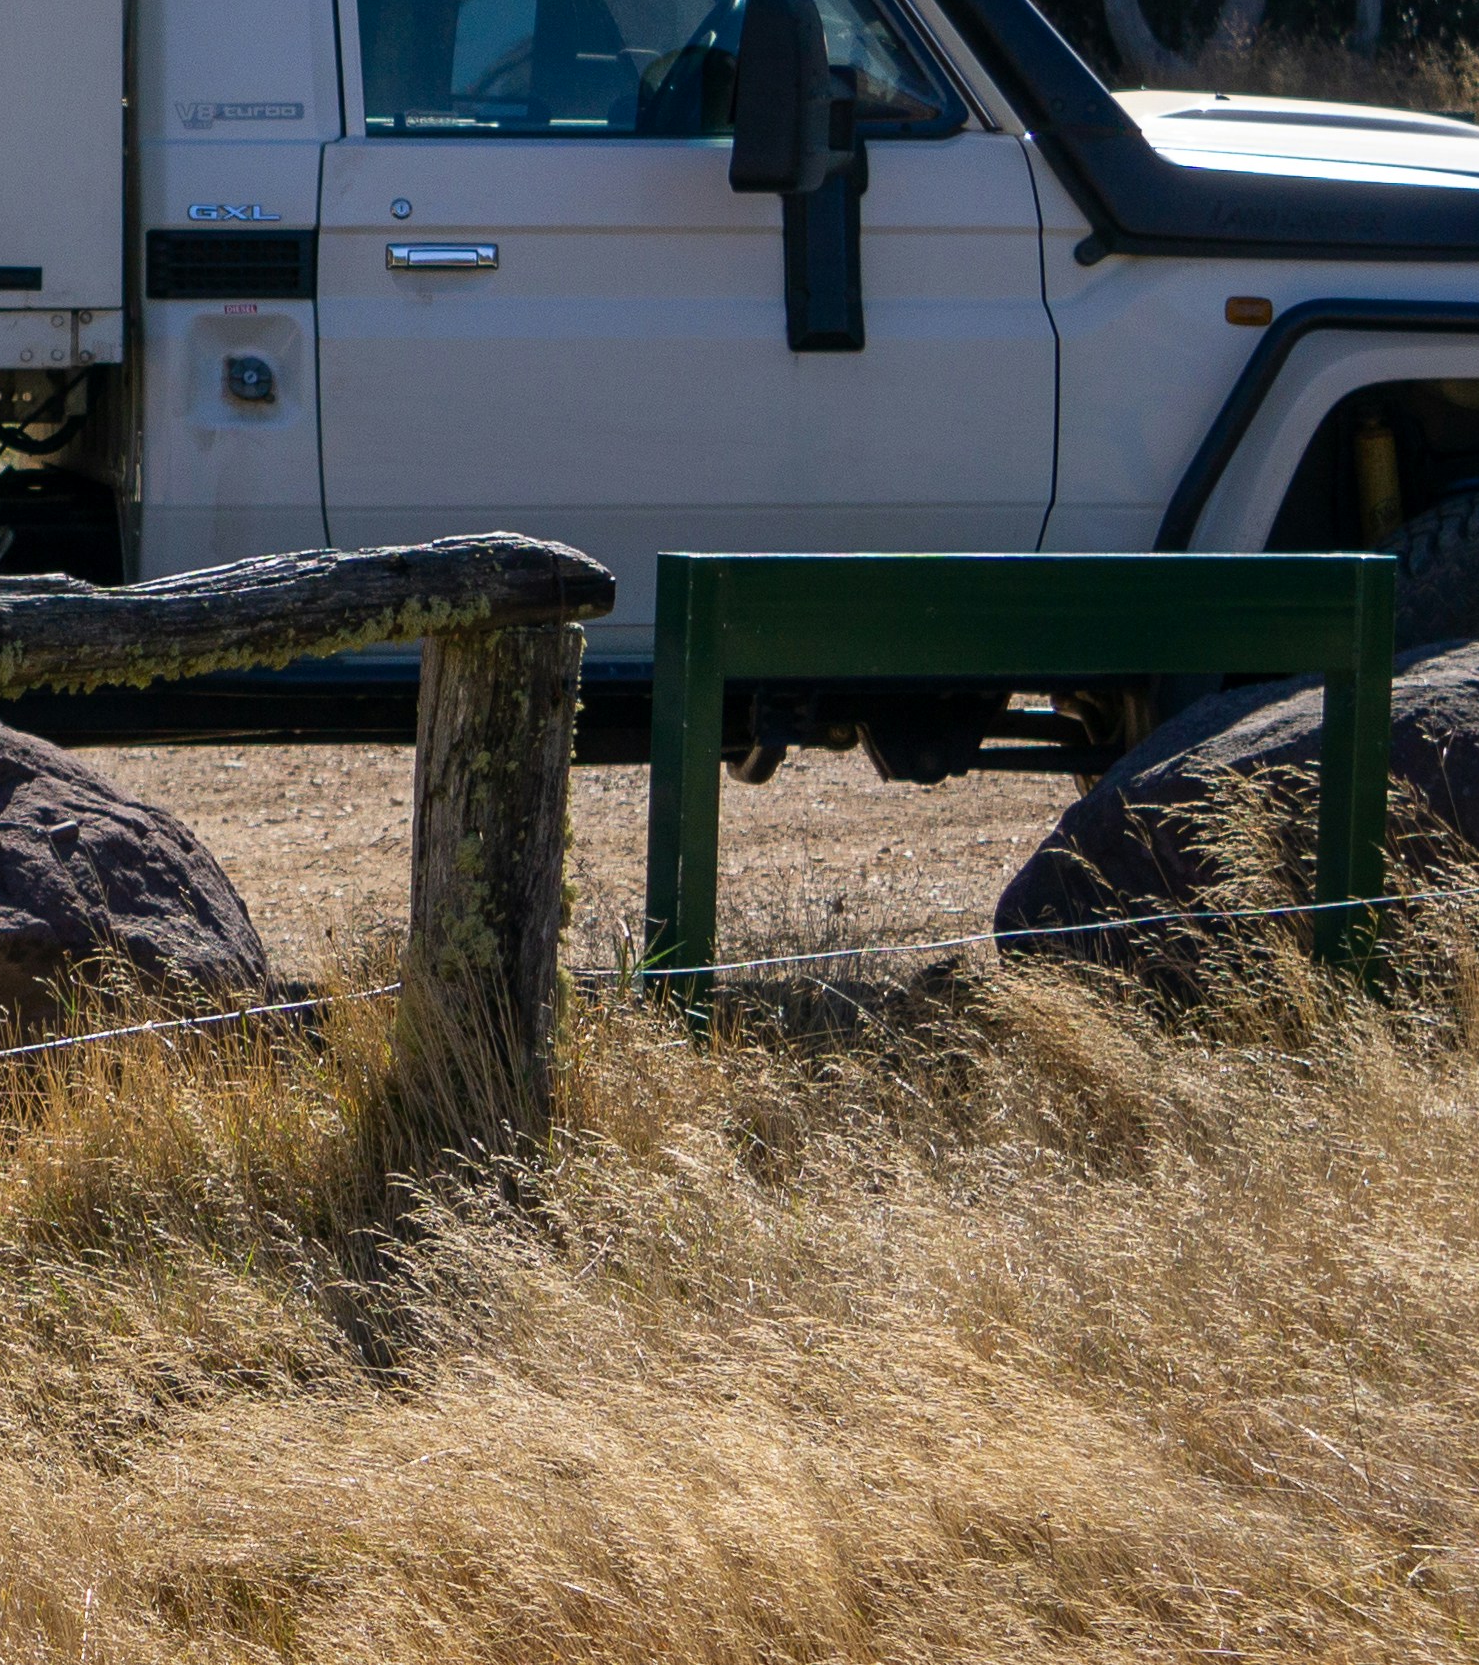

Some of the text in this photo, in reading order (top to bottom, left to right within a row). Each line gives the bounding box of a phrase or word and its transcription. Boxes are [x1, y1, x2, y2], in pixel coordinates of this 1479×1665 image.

[174, 102, 297, 122] V8 turbo
[187, 204, 281, 221] GXL
